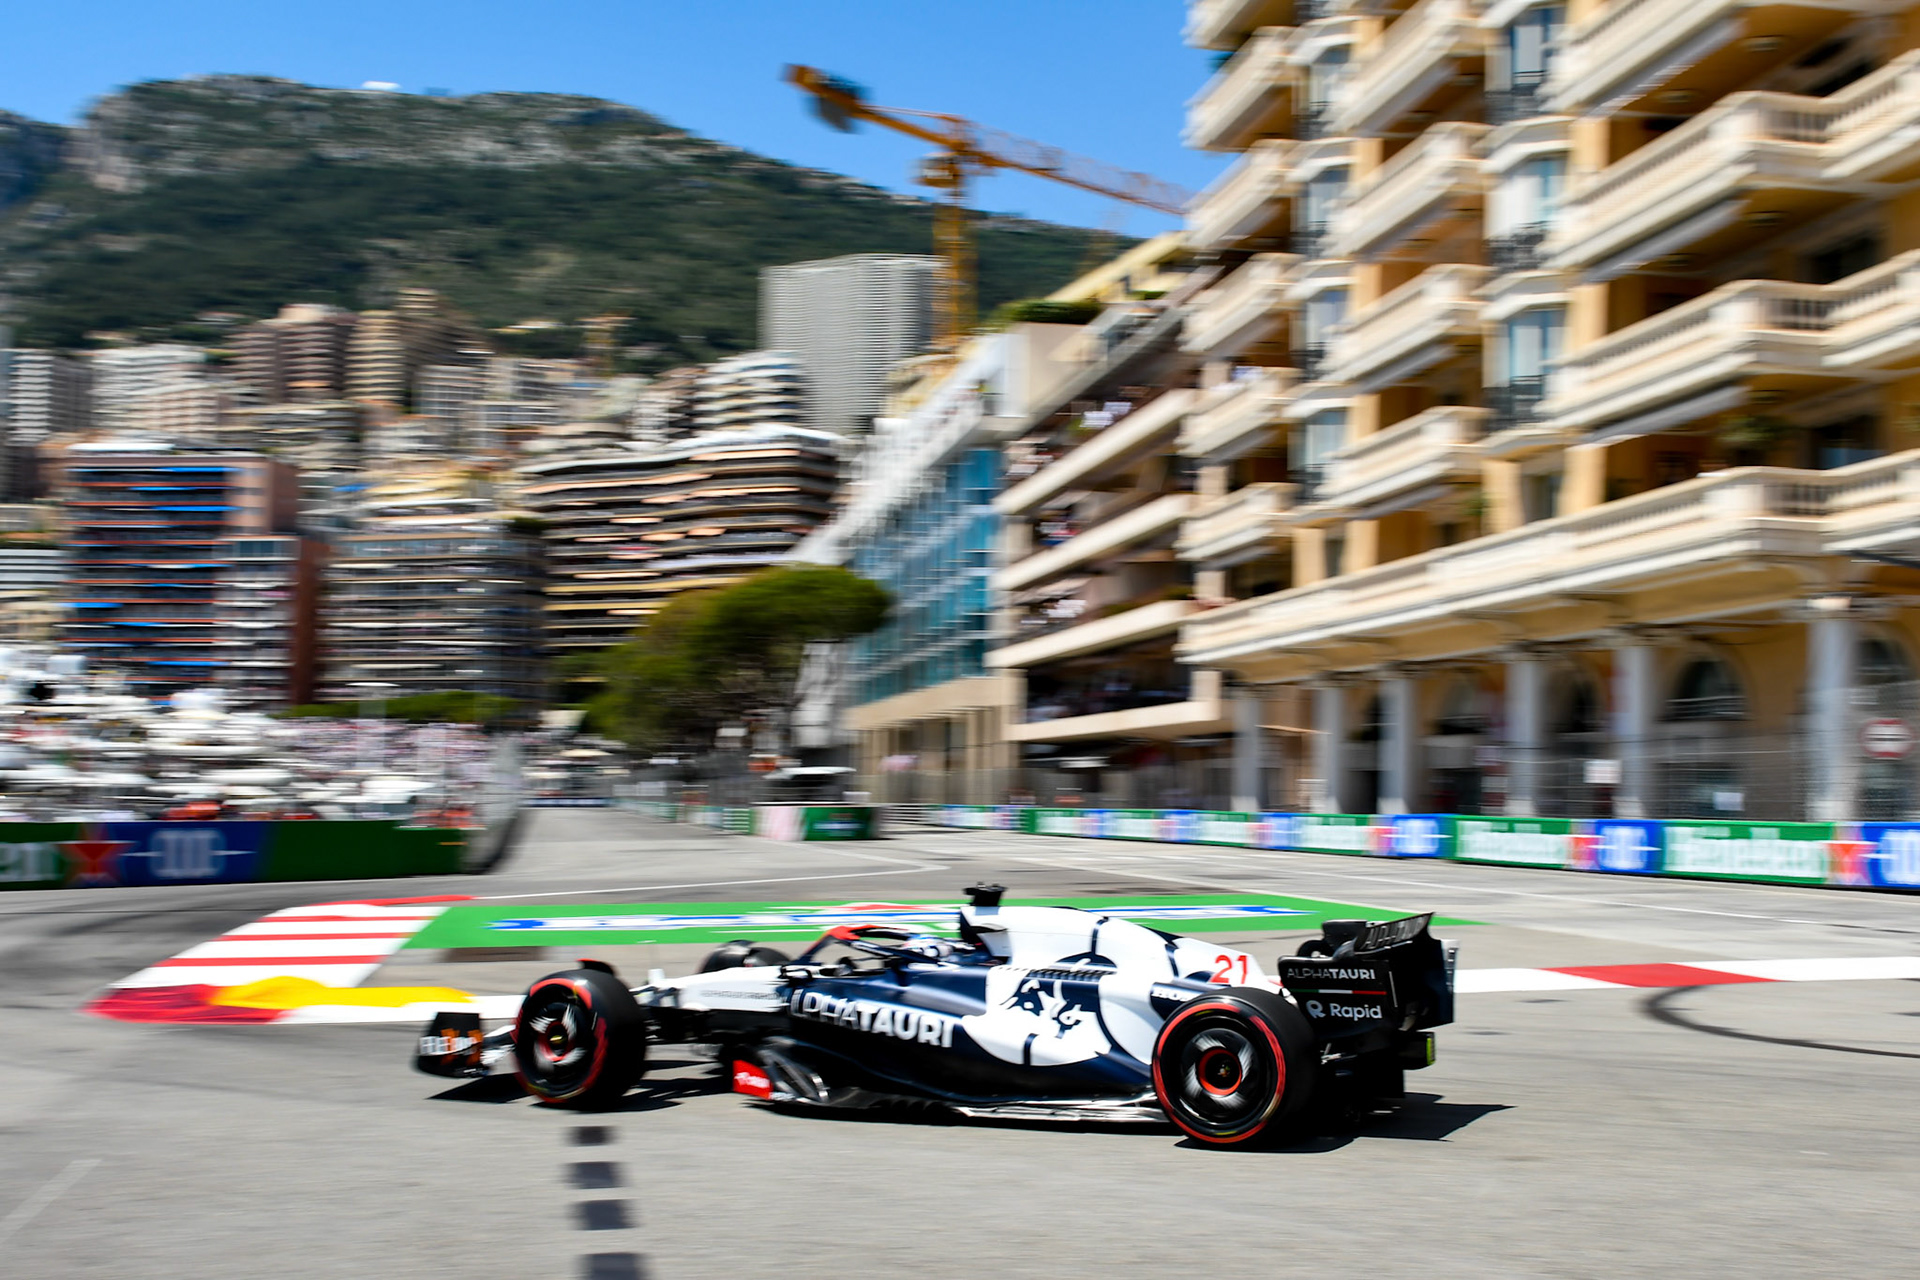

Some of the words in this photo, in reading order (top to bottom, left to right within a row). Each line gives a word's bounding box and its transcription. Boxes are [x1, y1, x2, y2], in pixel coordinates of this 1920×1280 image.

[1209, 954, 1248, 984] 21
[1286, 968, 1376, 980] ALPHATAURI
[1329, 1003, 1383, 1021] Rapid
